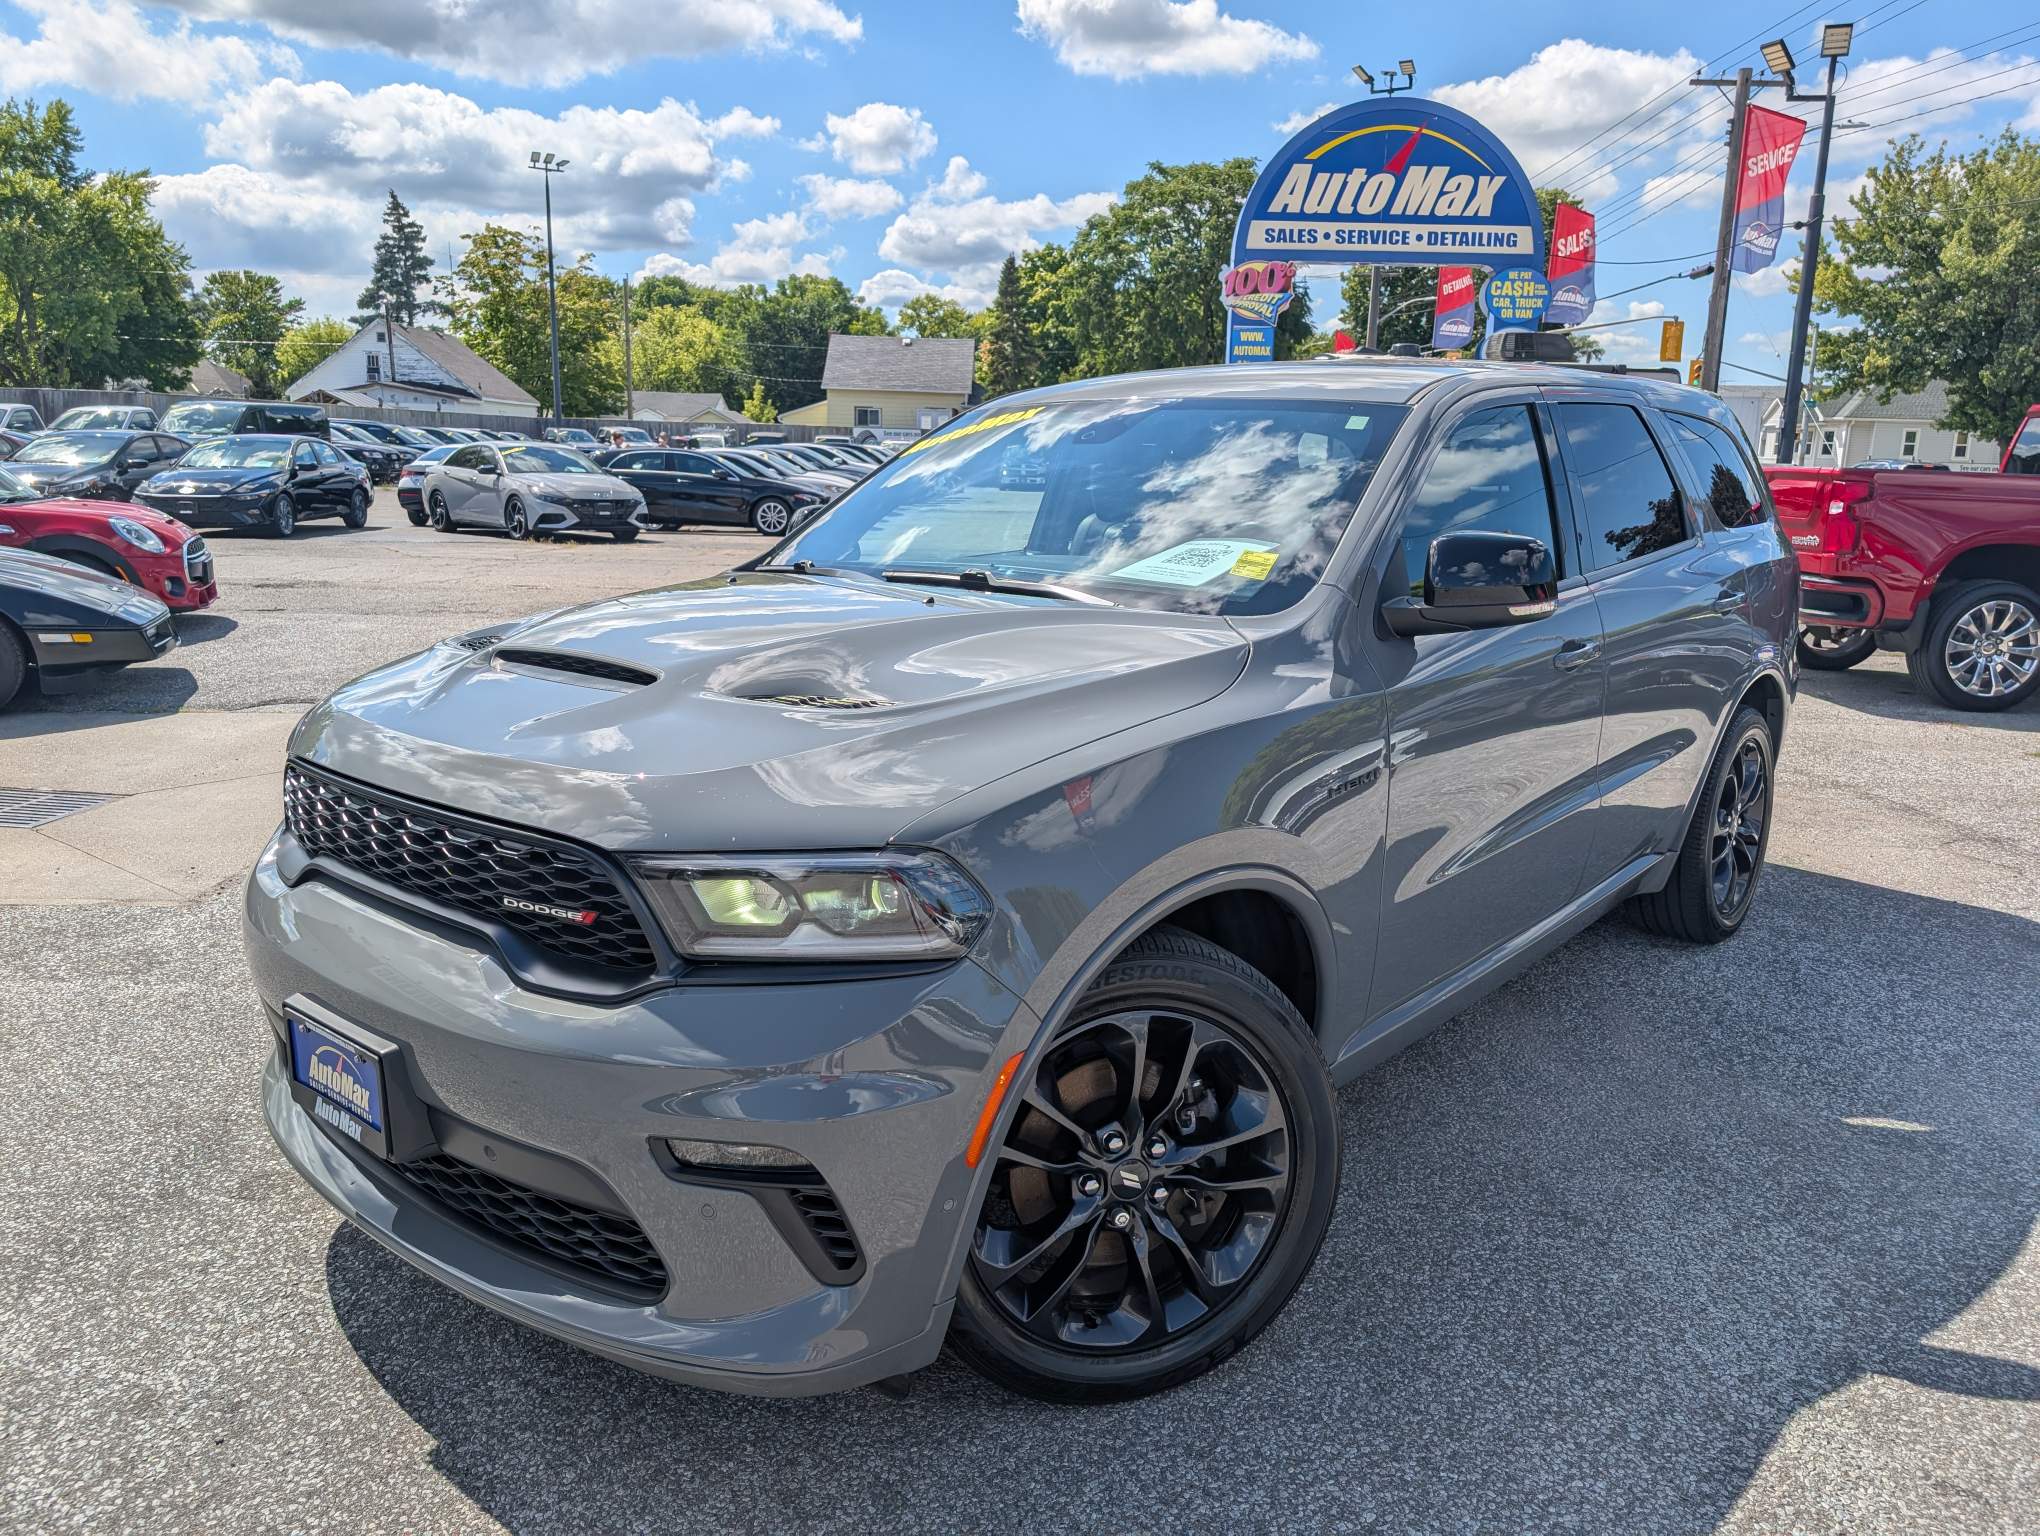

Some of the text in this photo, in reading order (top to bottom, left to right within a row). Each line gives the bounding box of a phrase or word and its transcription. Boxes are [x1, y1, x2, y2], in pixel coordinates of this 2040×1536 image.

[1747, 143, 1796, 177] SERVICE
[1266, 163, 1508, 218] AutoMax
[1264, 228, 1518, 248] SALES SERVICE DETAILING
[1556, 228, 1594, 257] SALES
[1224, 260, 1296, 297] 100%
[1501, 308, 1533, 319] OR VAN
[1515, 297, 1543, 308] TRUCK
[1233, 346, 1270, 356] AUTOMAX
[503, 897, 583, 922] DODGE
